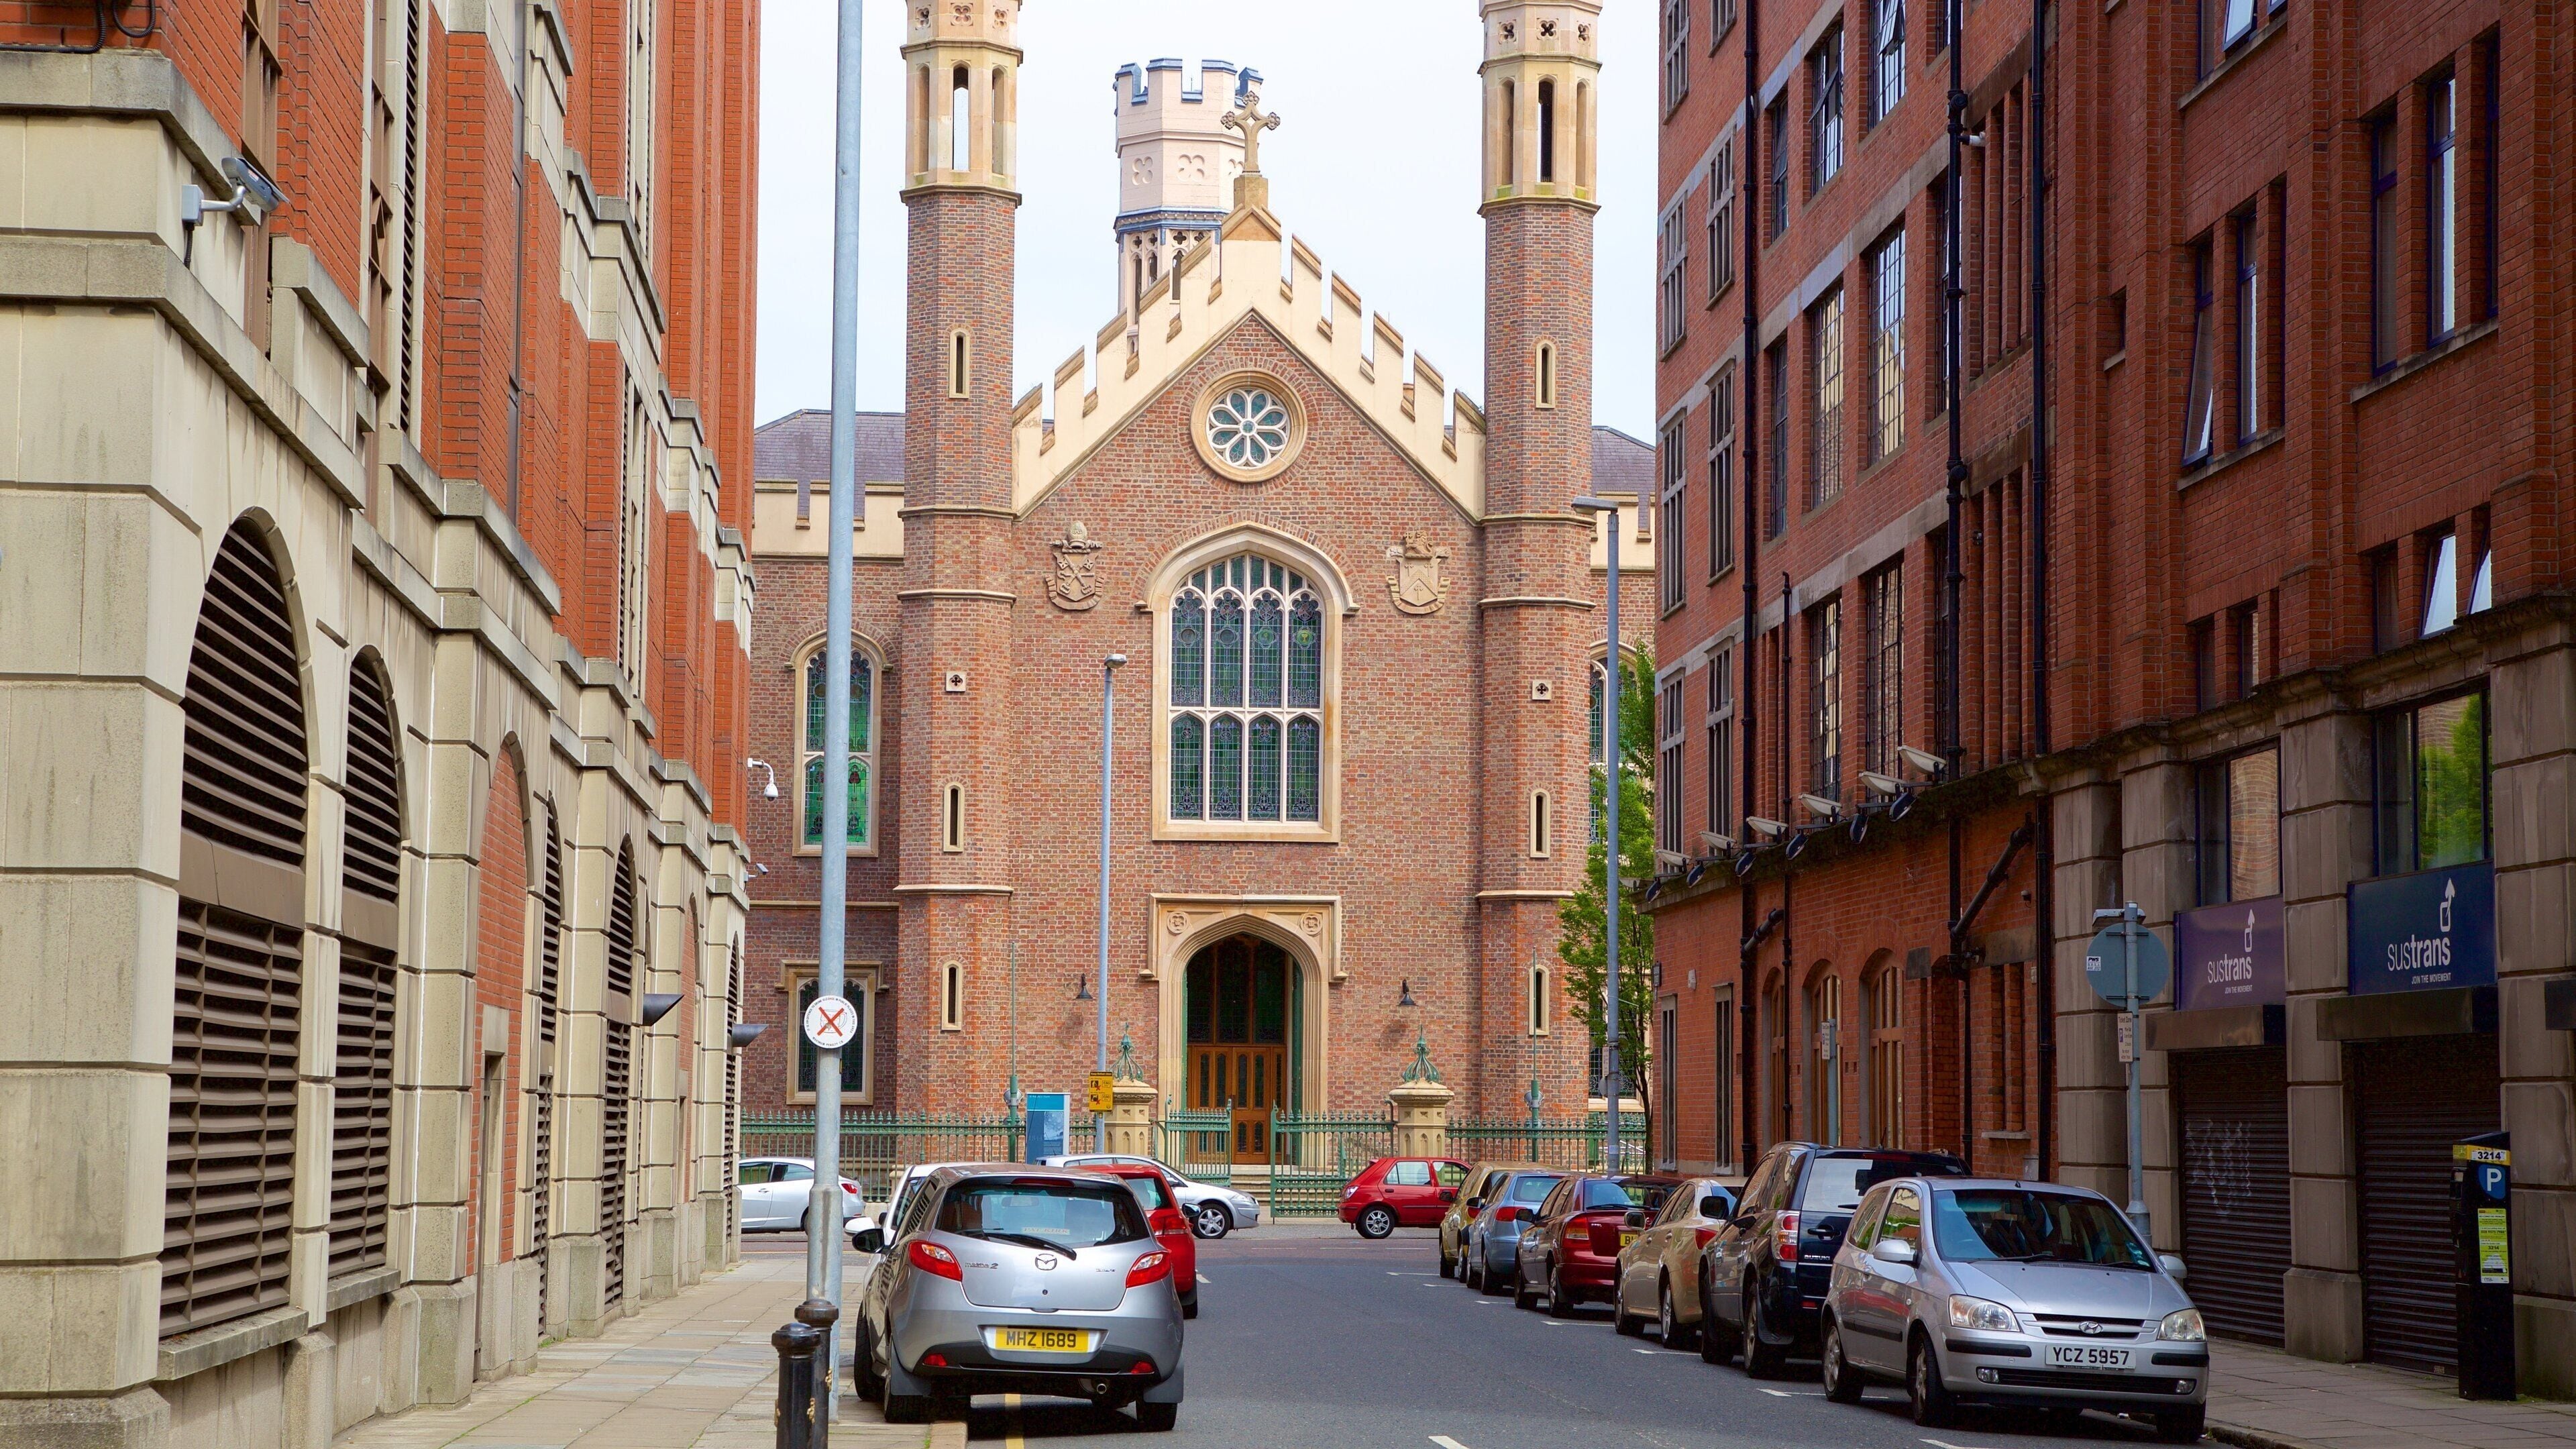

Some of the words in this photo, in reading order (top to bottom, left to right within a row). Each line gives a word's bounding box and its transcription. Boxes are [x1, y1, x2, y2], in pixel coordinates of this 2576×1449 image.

[2388, 934, 2451, 971] sustrans
[2208, 953, 2252, 983] sustrans
[2412, 975, 2420, 984] JOIN
[2429, 973, 2451, 983] MOVEMENT
[2477, 1151, 2502, 1160] 3214
[2487, 1168, 2502, 1191] P
[1006, 1330, 1037, 1346] MHZ
[1041, 1332, 1076, 1348] 1689
[2053, 1346, 2084, 1363] YCZ
[2088, 1348, 2129, 1365] 5957
